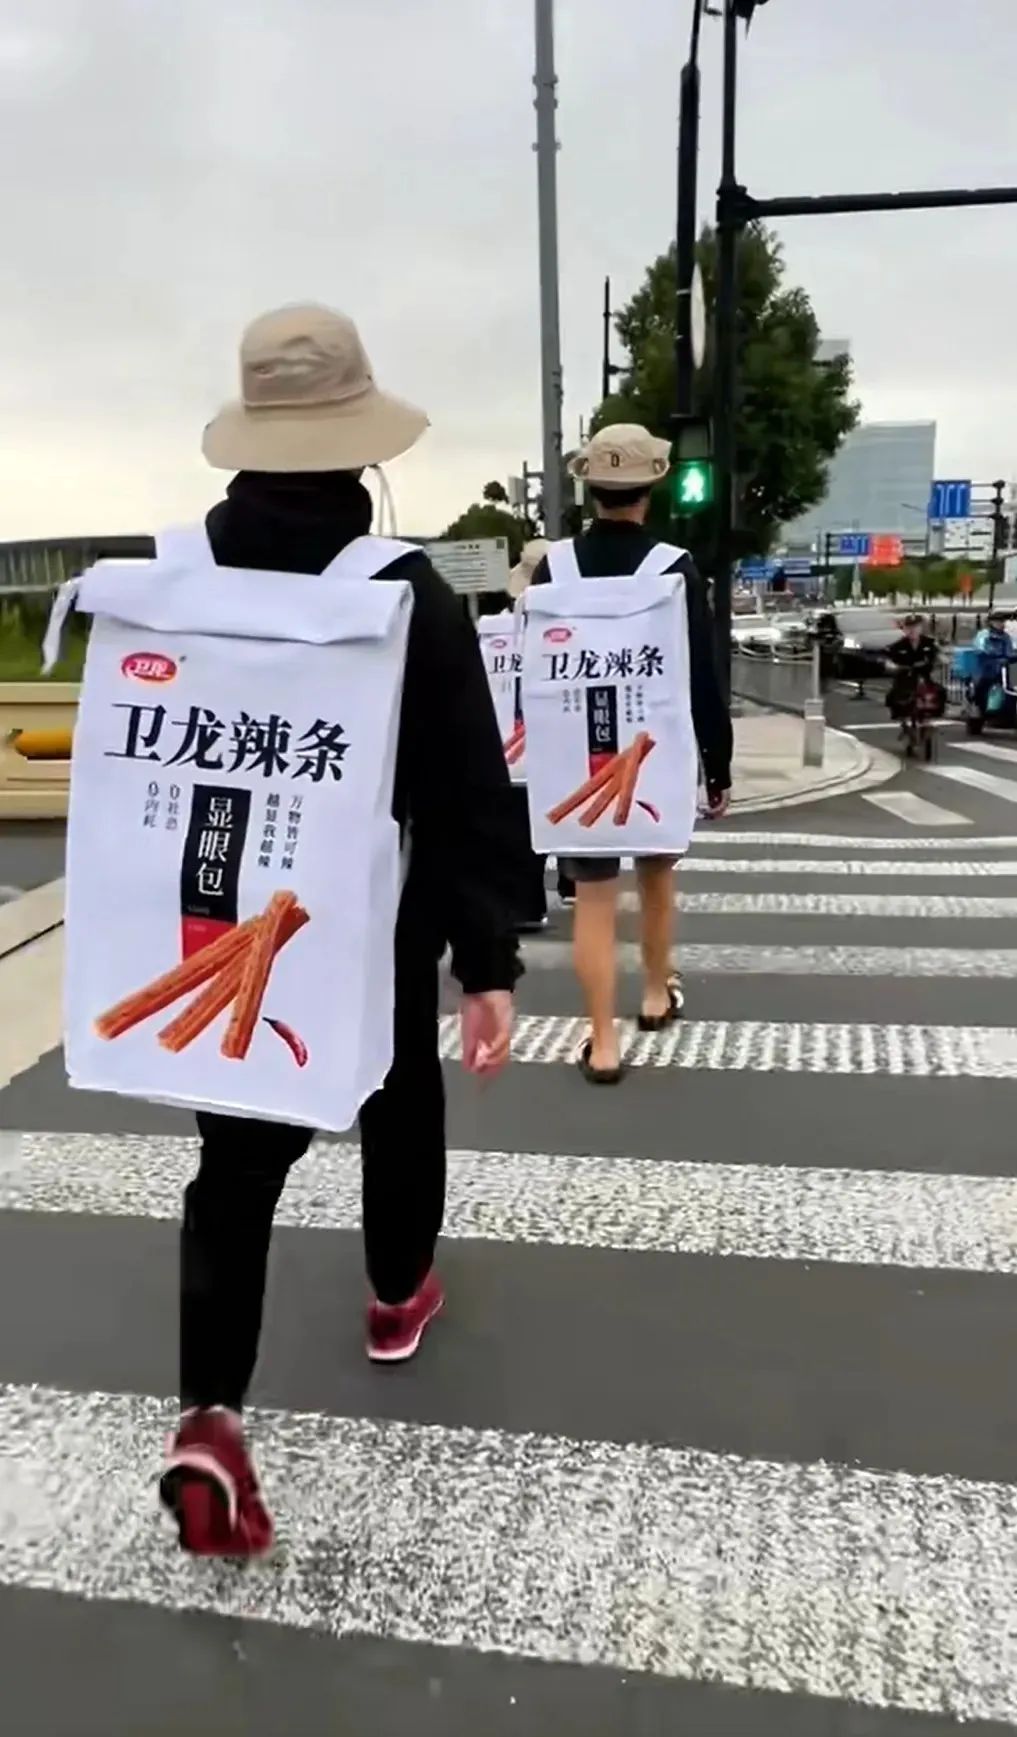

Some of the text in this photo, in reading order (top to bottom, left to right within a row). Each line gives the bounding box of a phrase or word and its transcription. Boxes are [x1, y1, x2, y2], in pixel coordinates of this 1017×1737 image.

[541, 645, 665, 681] 卫龙辣条
[104, 703, 351, 782] 卫龙辣条
[196, 796, 234, 896] 显眼包
